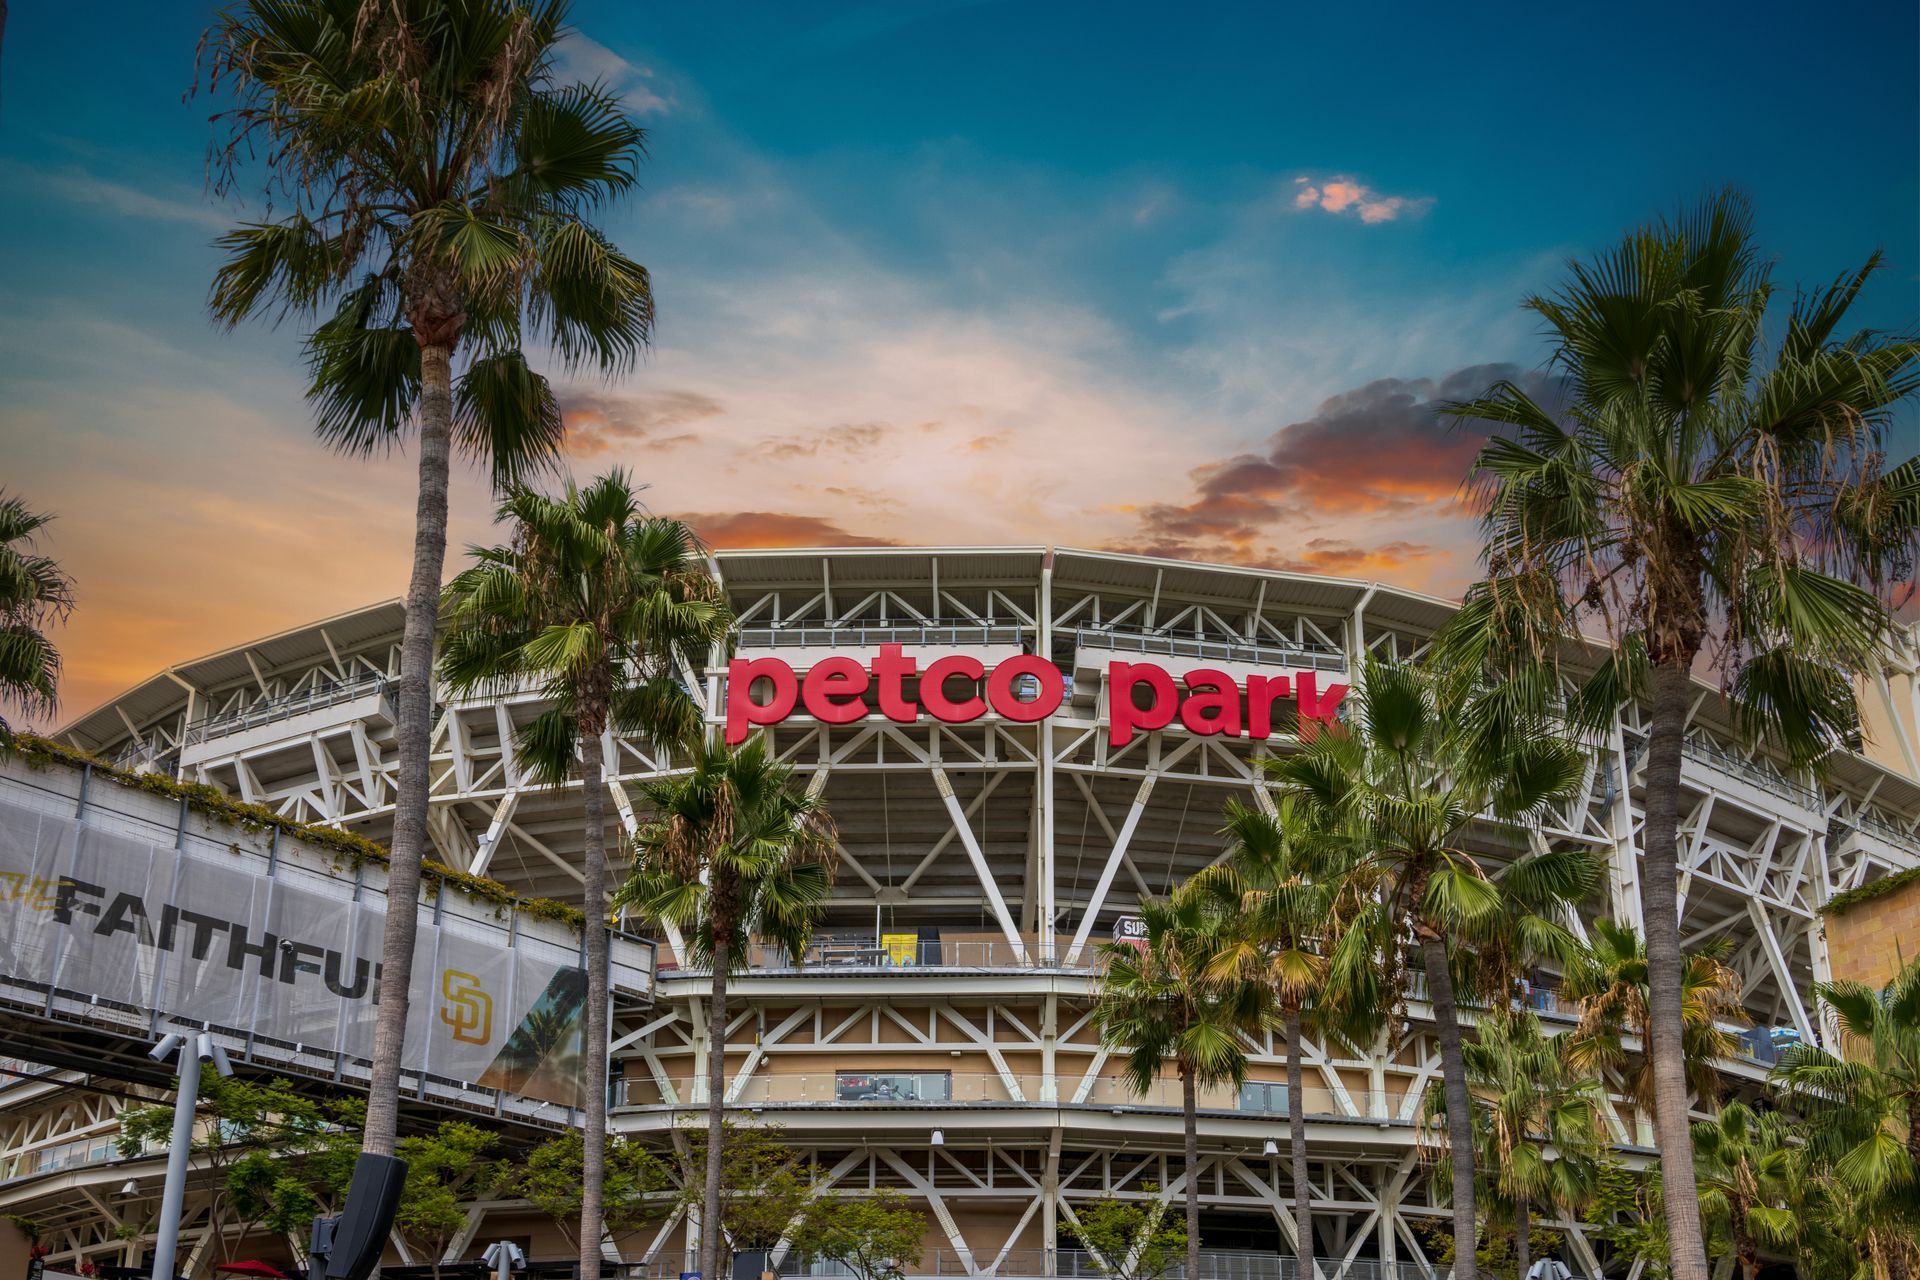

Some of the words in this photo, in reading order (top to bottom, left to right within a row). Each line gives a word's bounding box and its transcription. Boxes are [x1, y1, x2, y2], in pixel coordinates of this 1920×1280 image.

[725, 643, 1065, 745] petco
[1109, 662, 1351, 747] park
[440, 968, 493, 1046] SD
